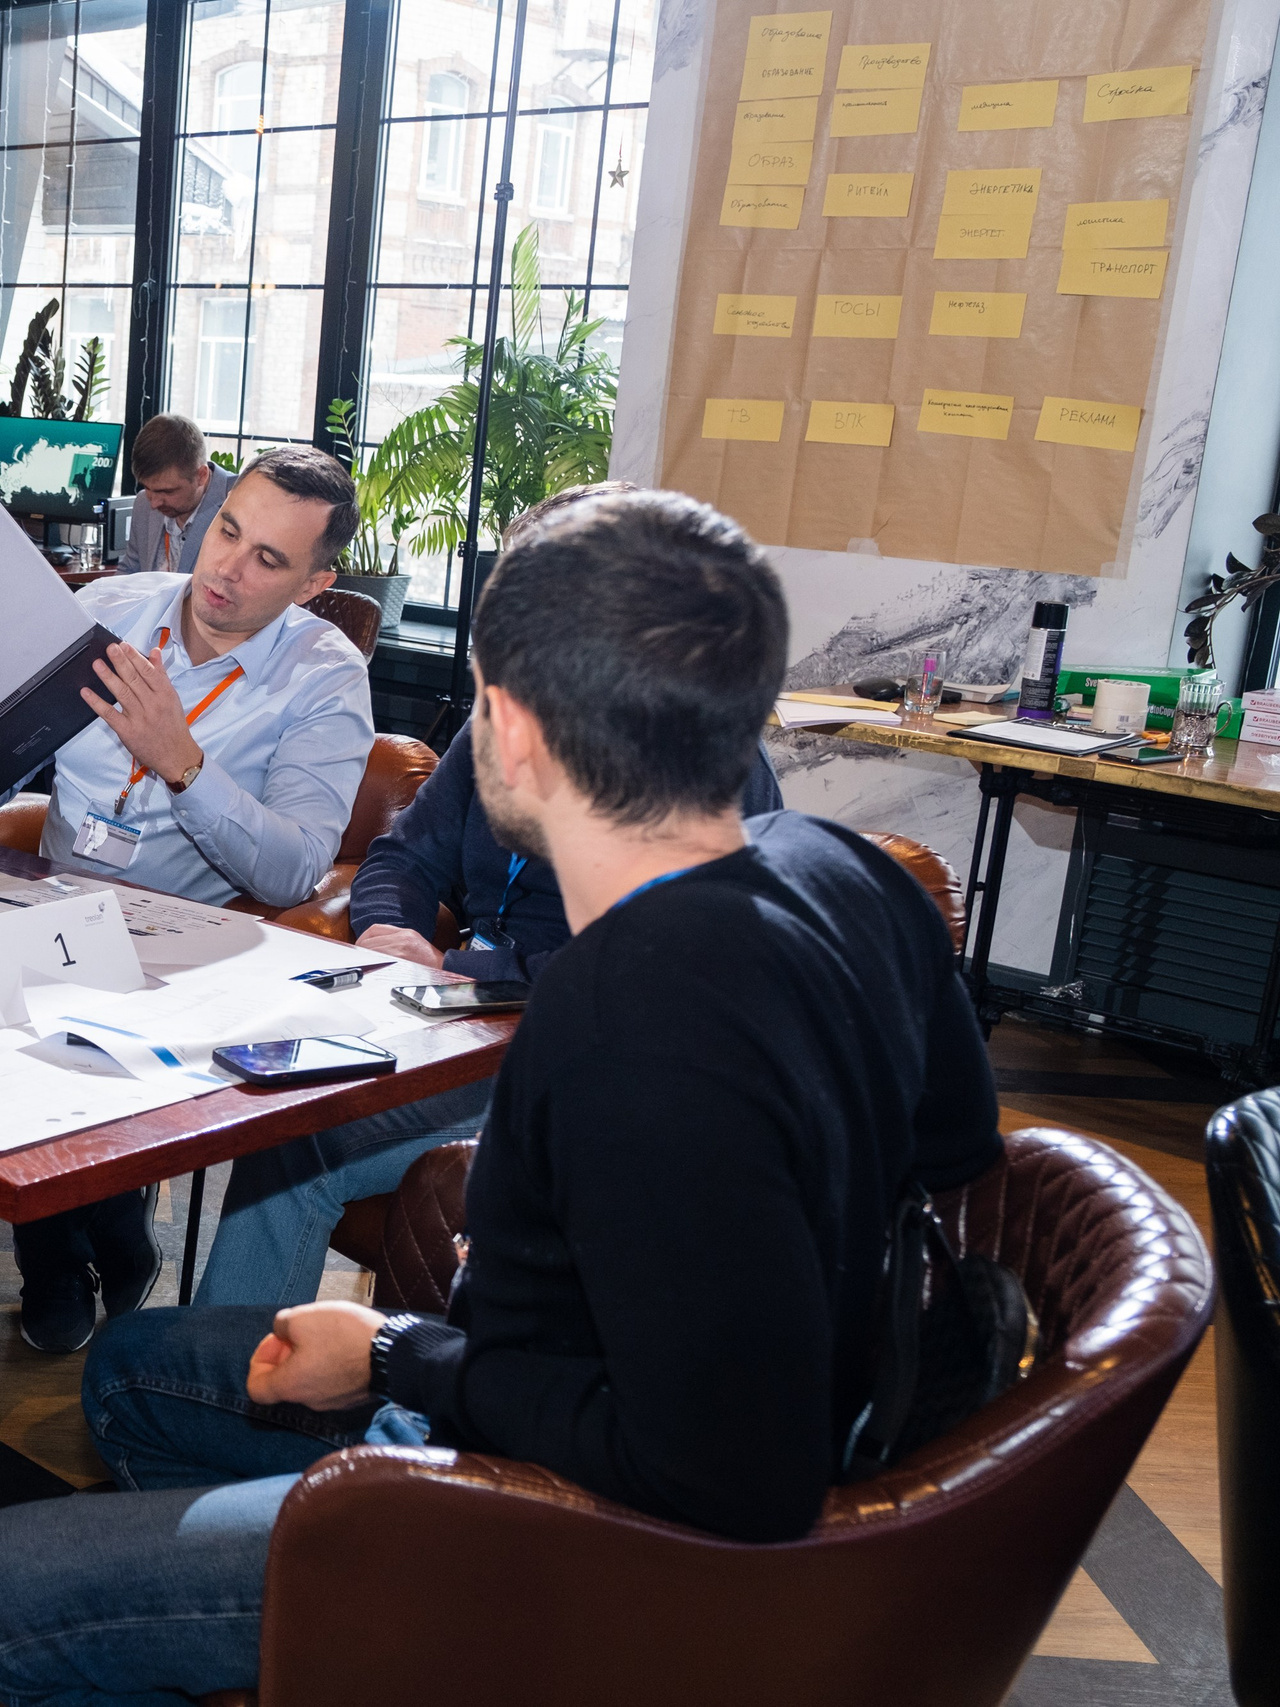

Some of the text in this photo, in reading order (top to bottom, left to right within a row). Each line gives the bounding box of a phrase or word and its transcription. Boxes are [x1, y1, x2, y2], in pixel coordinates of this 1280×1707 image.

[1097, 83, 1155, 104] Стройка
[1059, 407, 1116, 428] РЕКЛАМА
[54, 932, 77, 967] 1
